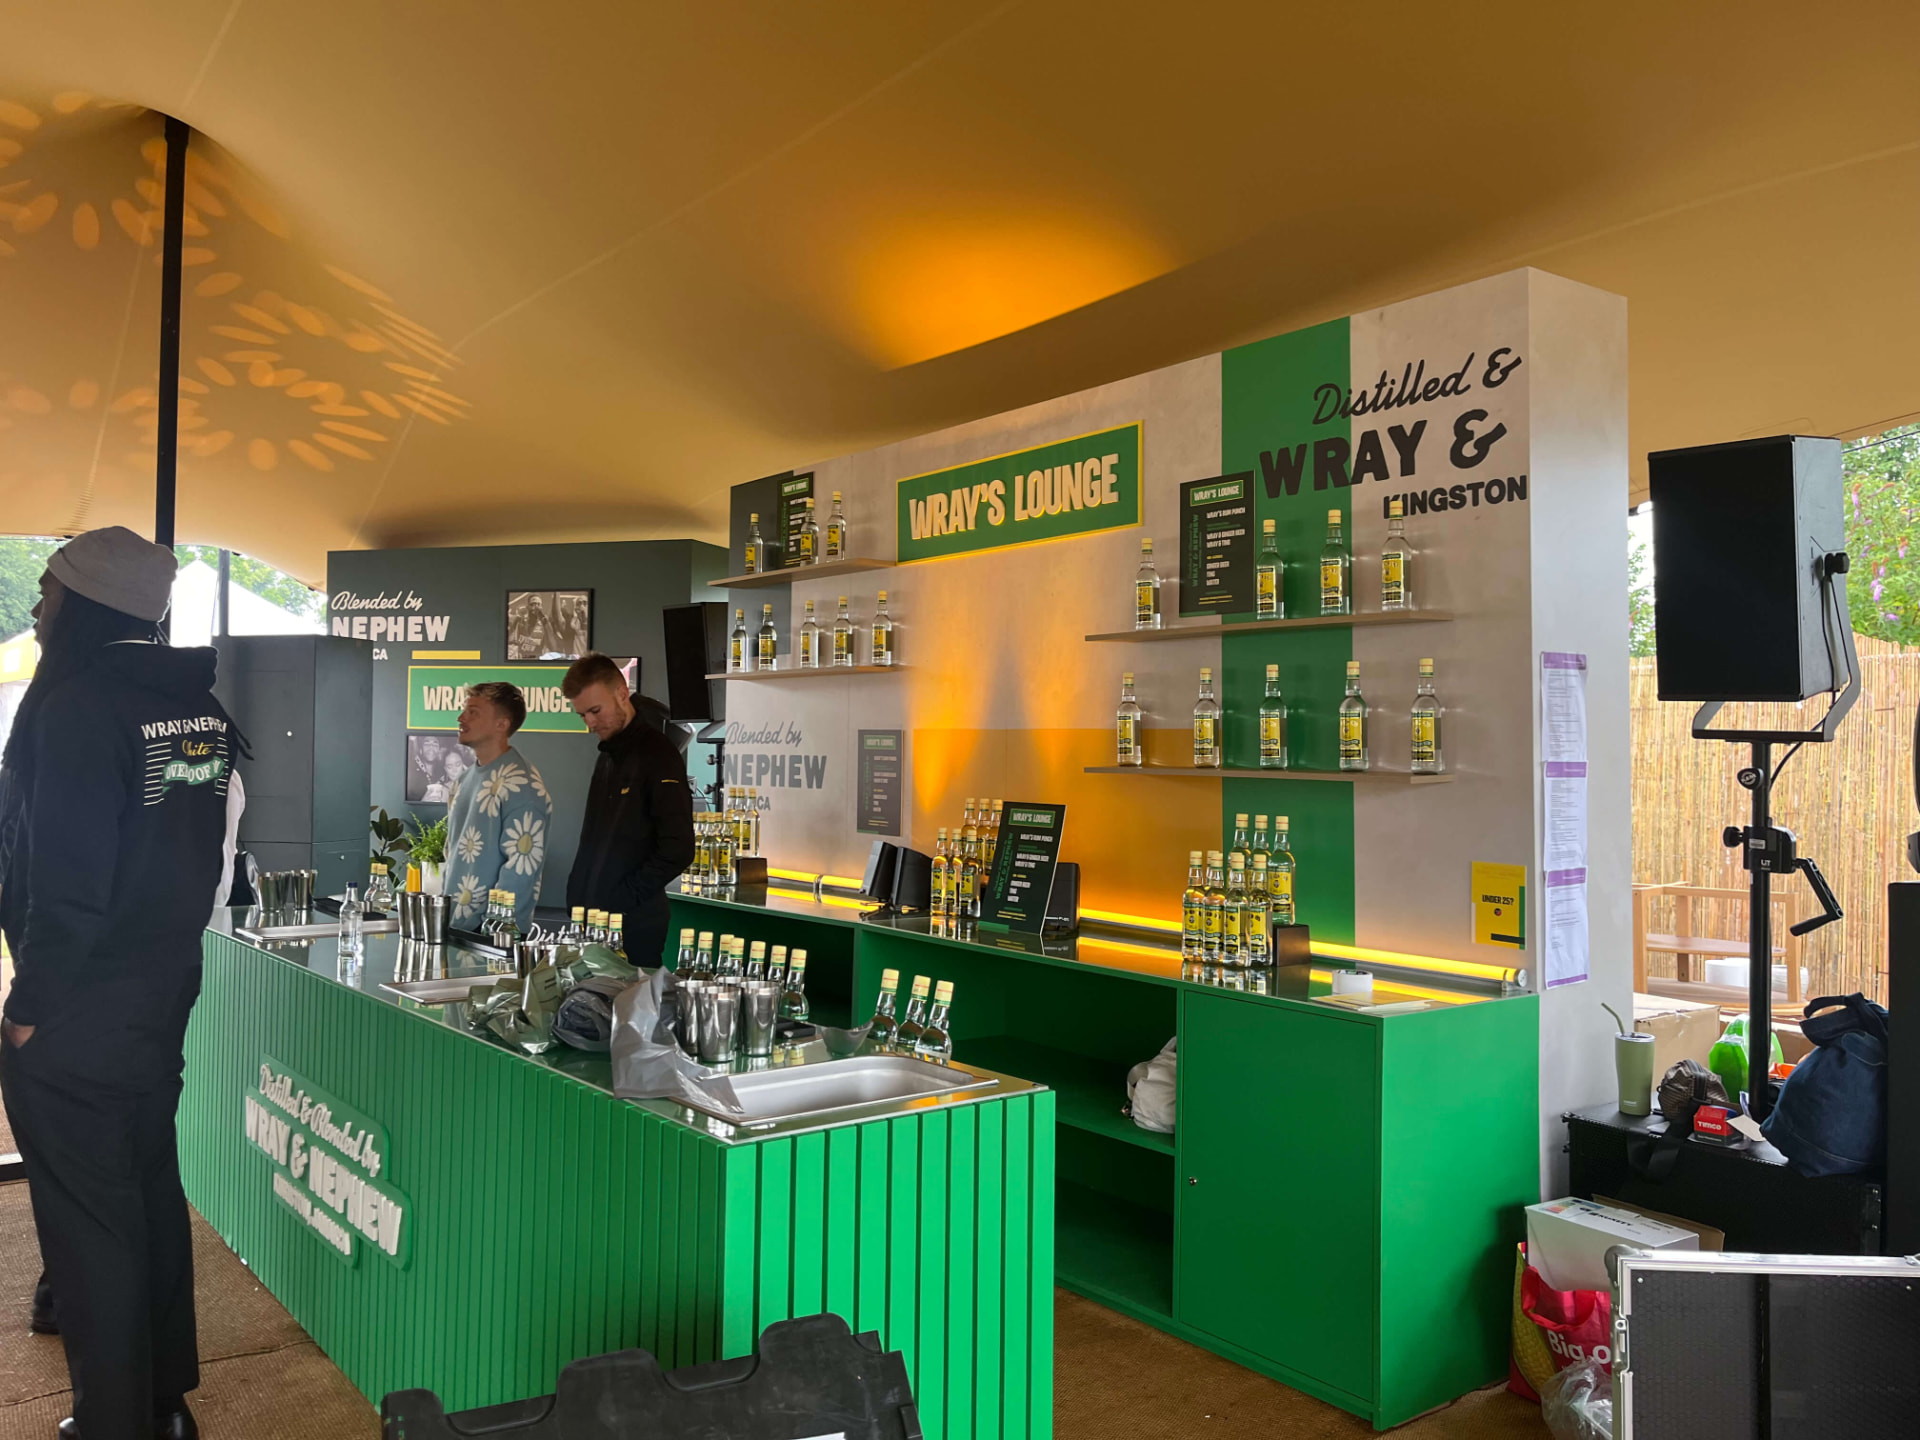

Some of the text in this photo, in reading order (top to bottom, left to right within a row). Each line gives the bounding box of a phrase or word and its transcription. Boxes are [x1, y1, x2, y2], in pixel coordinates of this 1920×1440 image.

[1312, 347, 1522, 425] Distilled &
[1259, 408, 1507, 499] WRAY &
[909, 453, 1119, 540] WRAY'S LOUNGE
[1194, 485, 1240, 501] WRAY'S LOUNGE
[1383, 475, 1528, 519] KINGSTON
[331, 589, 424, 612] Blended by
[332, 615, 451, 642] NEPHEW
[423, 685, 464, 712] WRA
[725, 721, 803, 747] Blended by
[725, 754, 827, 789] NEPHEW
[1481, 894, 1514, 905] UNDER 25?
[260, 1063, 304, 1119] Distilled
[310, 1103, 366, 1162] Blended
[1697, 1121, 1722, 1130] TIMCO
[246, 1096, 402, 1256] WRAY & NEPHEW
